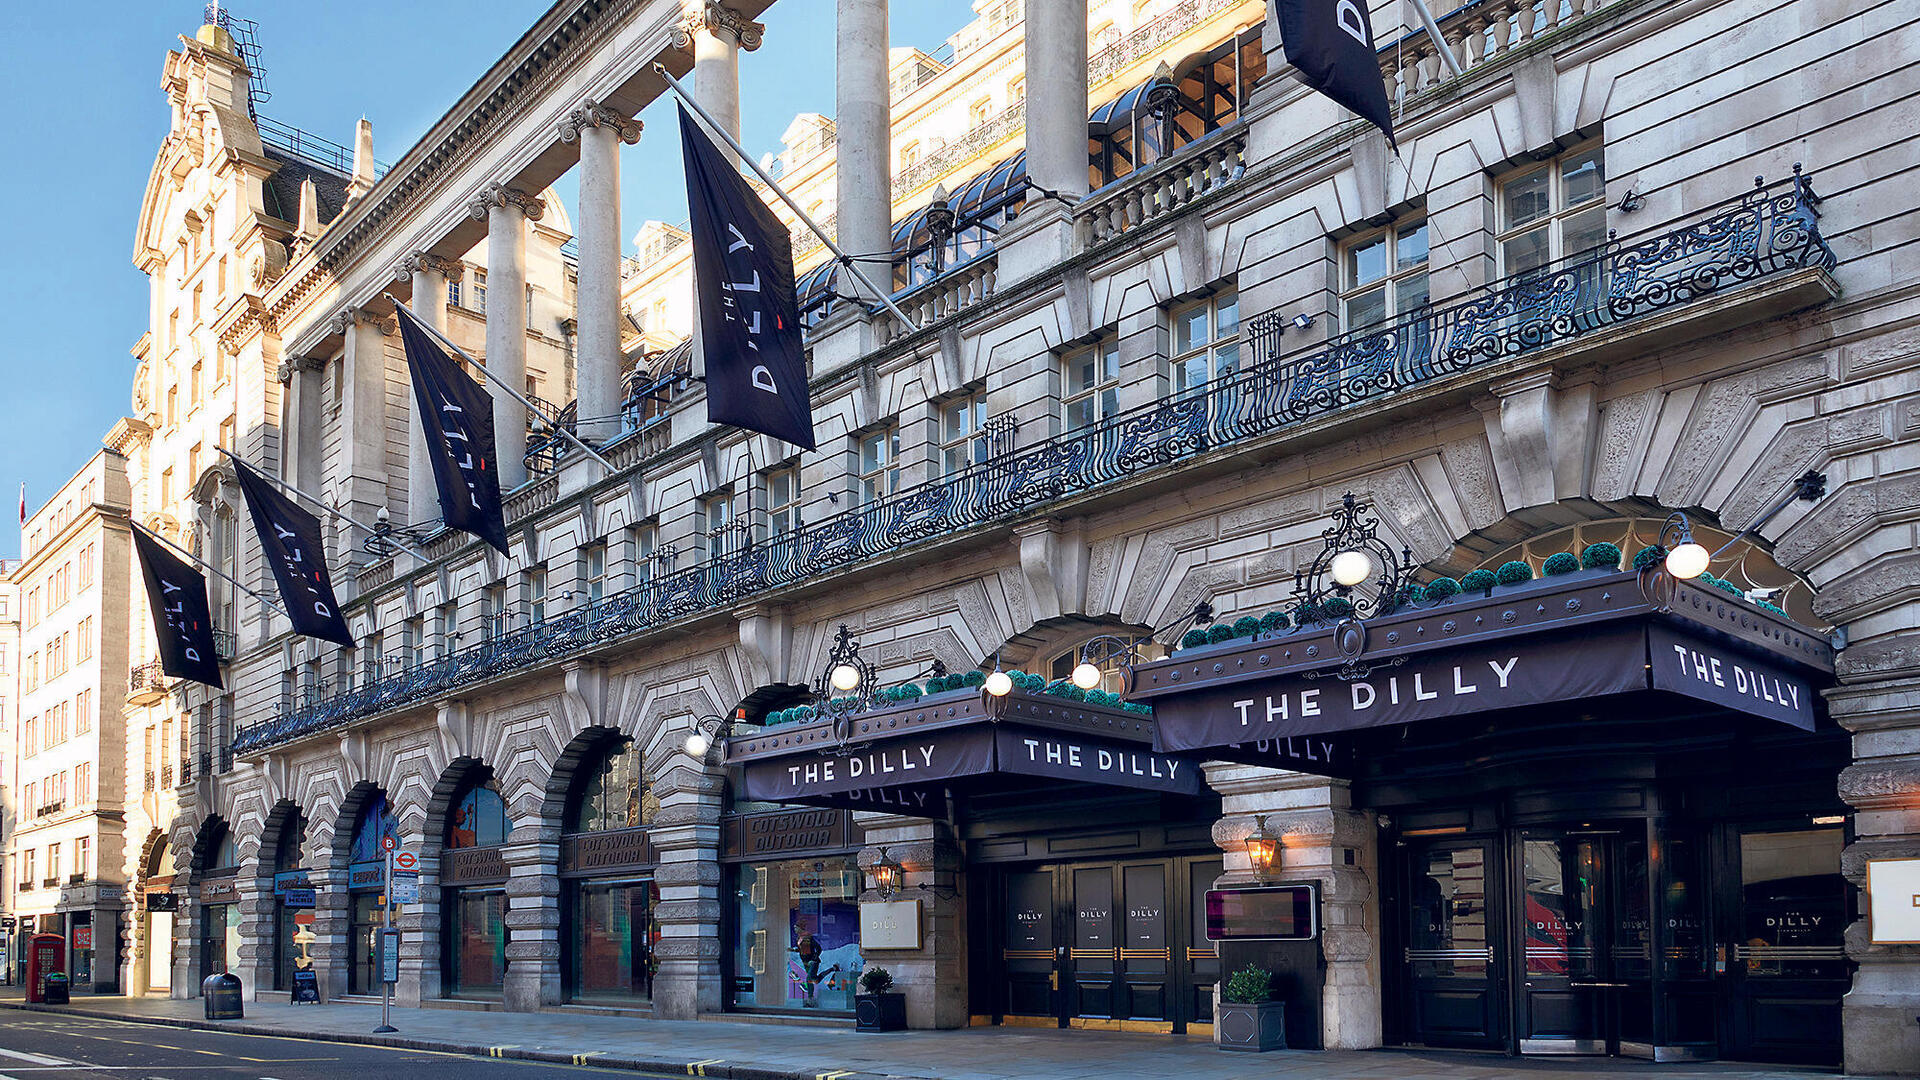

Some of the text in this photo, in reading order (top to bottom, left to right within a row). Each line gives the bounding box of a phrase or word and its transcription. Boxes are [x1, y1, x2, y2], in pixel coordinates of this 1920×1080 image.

[722, 281, 735, 321] THE
[1674, 644, 1799, 710] THE DILLY
[1233, 656, 1519, 726] THE DILLY
[788, 745, 935, 786] THE DILLY
[1023, 739, 1179, 780] THE DILLY
[751, 811, 838, 834] COTSWOLD
[386, 839, 393, 848] B
[583, 832, 645, 851] COTSWOLD
[755, 830, 831, 850] OUTDOOR
[586, 849, 641, 867] OUTDOOR
[1131, 909, 1159, 917] DILLY
[1766, 916, 1821, 926] DILLY
[1536, 921, 1583, 930] DILLY
